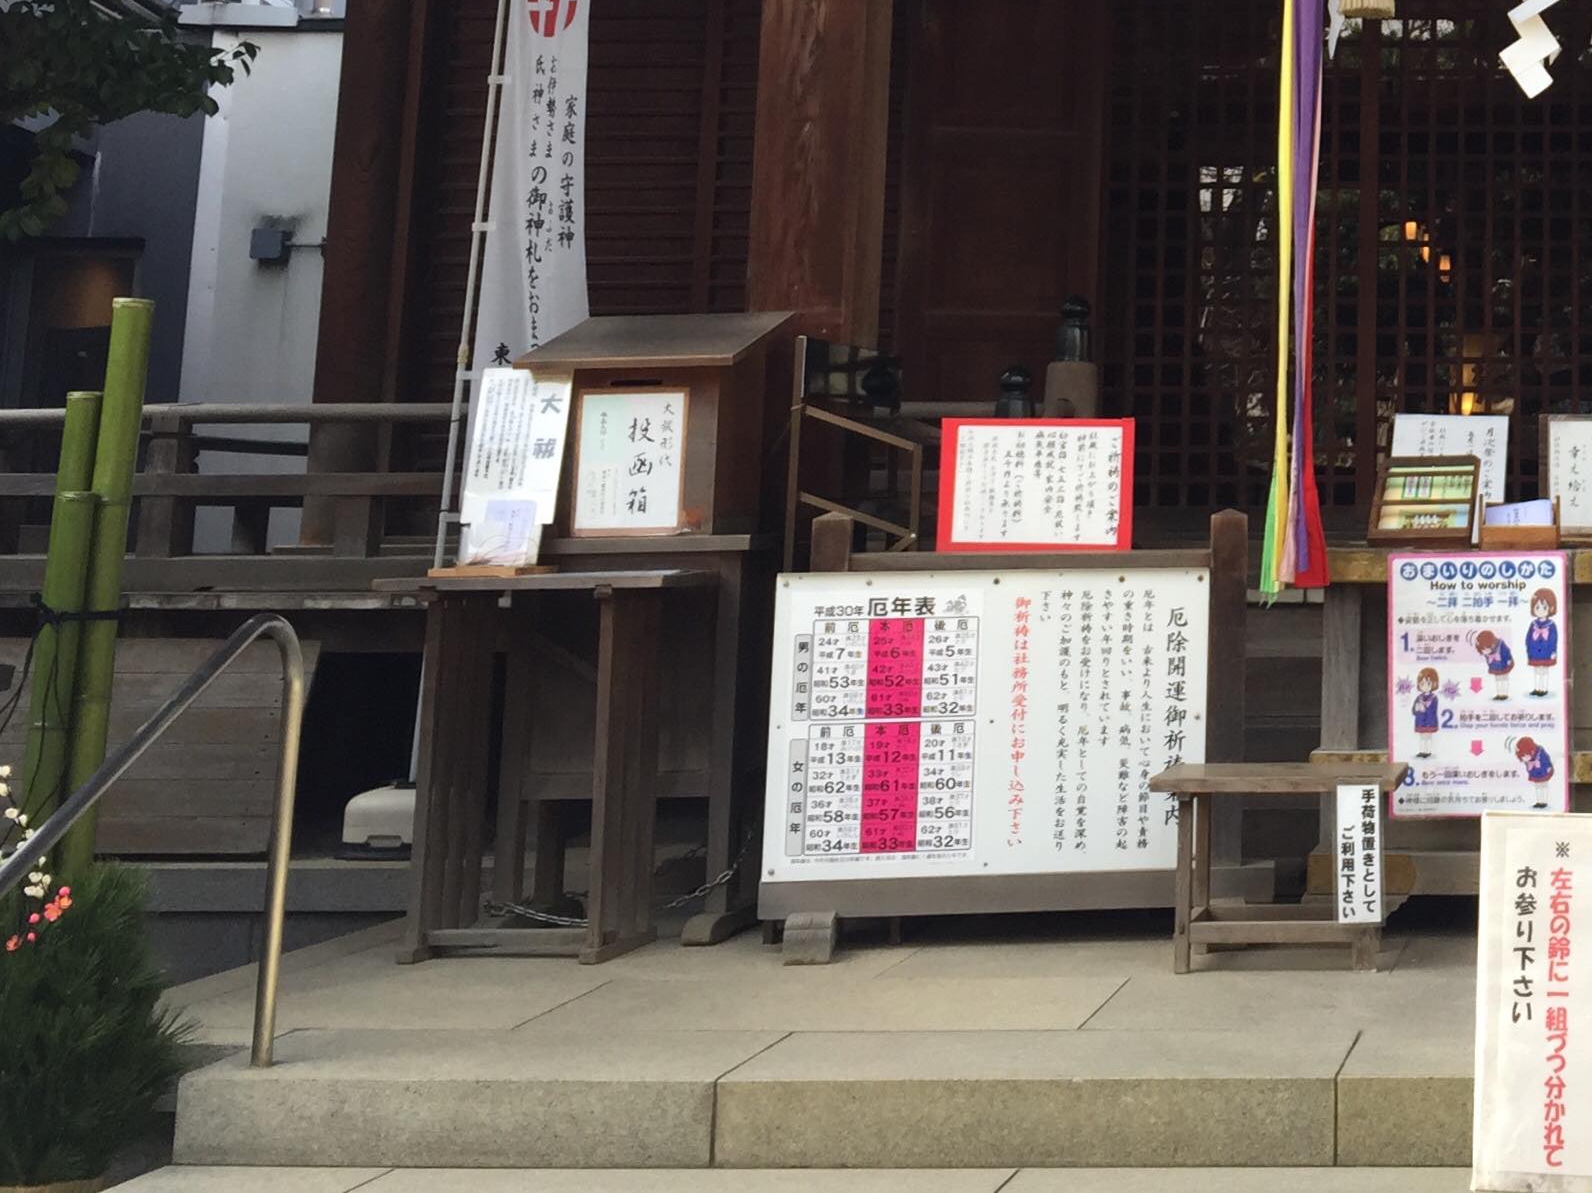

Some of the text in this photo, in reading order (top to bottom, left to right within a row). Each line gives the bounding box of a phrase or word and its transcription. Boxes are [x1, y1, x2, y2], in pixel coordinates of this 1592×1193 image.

[529, 54, 546, 157] 氏神さま
[545, 55, 558, 158] お伊勢さま
[557, 94, 579, 250] 家庭の守護神
[491, 342, 512, 366] 東
[626, 417, 655, 515] 投函箱
[1568, 445, 1582, 508] 幸え給え
[1104, 437, 1121, 536] ご祈祷のご案内
[1401, 561, 1555, 580] おまいりのしかた
[1430, 580, 1526, 591] How to worship
[814, 596, 936, 618] 平成30年 厄年表
[1040, 590, 1052, 622] 下さい
[1462, 596, 1494, 608] 二拍手
[818, 647, 863, 660] 平成7年生
[929, 645, 972, 657] 平成5年生
[794, 641, 809, 714] 男の厄年
[1098, 589, 1114, 746] きやすい年回りとされています
[813, 676, 864, 689] 昭和53年生
[924, 673, 974, 686] 昭和51年生
[923, 702, 973, 714] 昭和32年生
[1163, 606, 1190, 827] 厄除開運御祈内
[1008, 596, 1032, 847] 御祈祷は社務所受付にお申し込み下さい
[810, 752, 861, 765] 平成13年生
[921, 749, 972, 761] 平成11年生
[809, 781, 859, 794] 昭和62年生
[920, 777, 970, 790] 昭和60年生
[789, 760, 804, 834] 女の厄年
[807, 810, 859, 823] 昭和58年生
[918, 806, 969, 820] 昭和56年生
[806, 840, 857, 852] 昭和34年生
[917, 836, 968, 848] 昭和32年生
[1361, 788, 1376, 913] 手荷物置きとして
[1341, 825, 1356, 918] ご利用下さい
[1511, 866, 1537, 1024] お参り下さい
